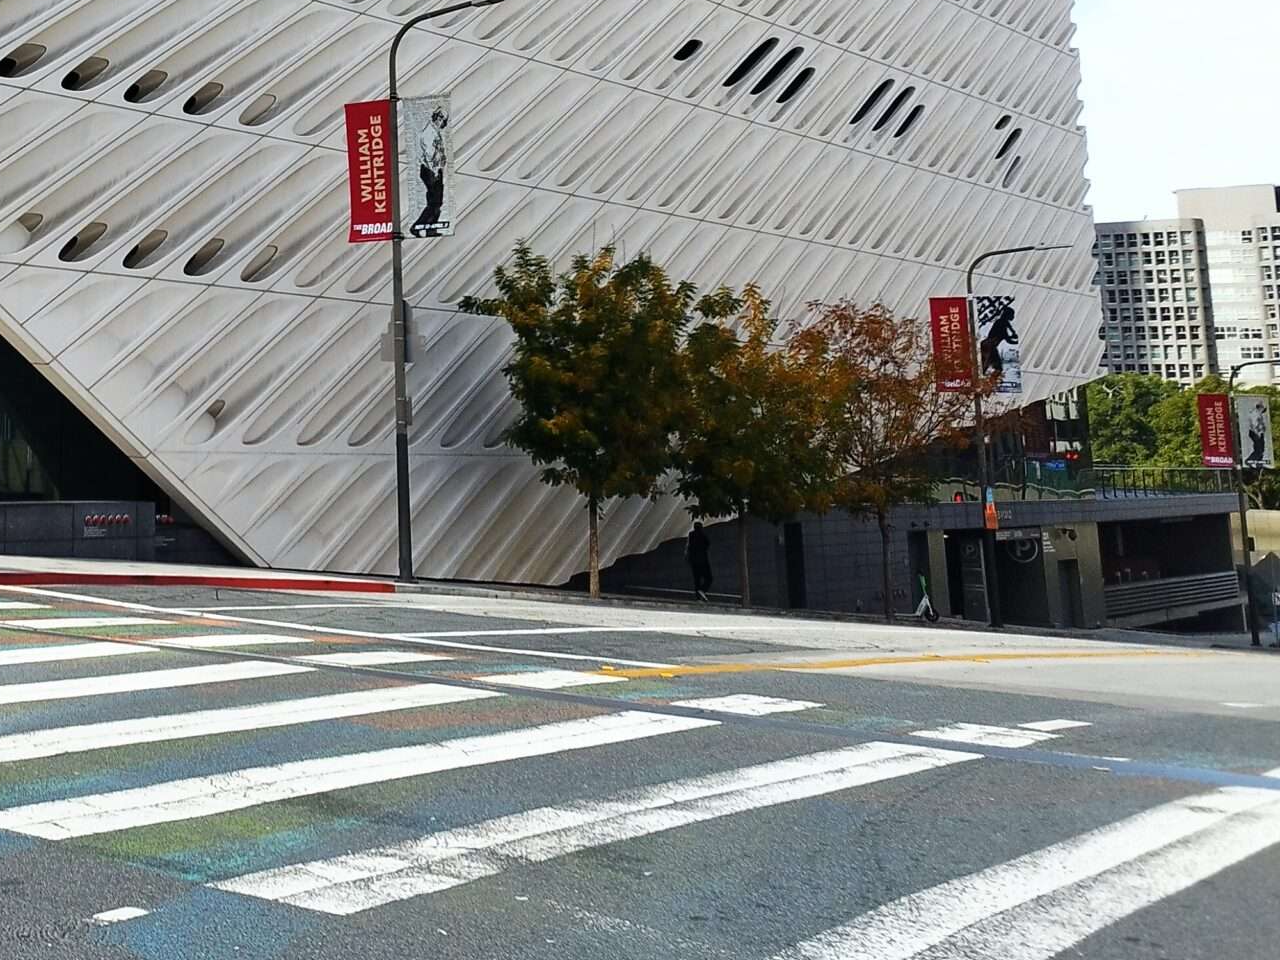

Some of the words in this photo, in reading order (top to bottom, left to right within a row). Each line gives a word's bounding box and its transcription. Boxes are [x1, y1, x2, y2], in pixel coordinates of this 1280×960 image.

[357, 128, 372, 203] WILLIAM
[369, 114, 386, 213] KENTRIDGE
[361, 222, 393, 235] BROAD
[1205, 407, 1217, 447] WILLIAM
[1215, 401, 1227, 453] KENTRIDGE
